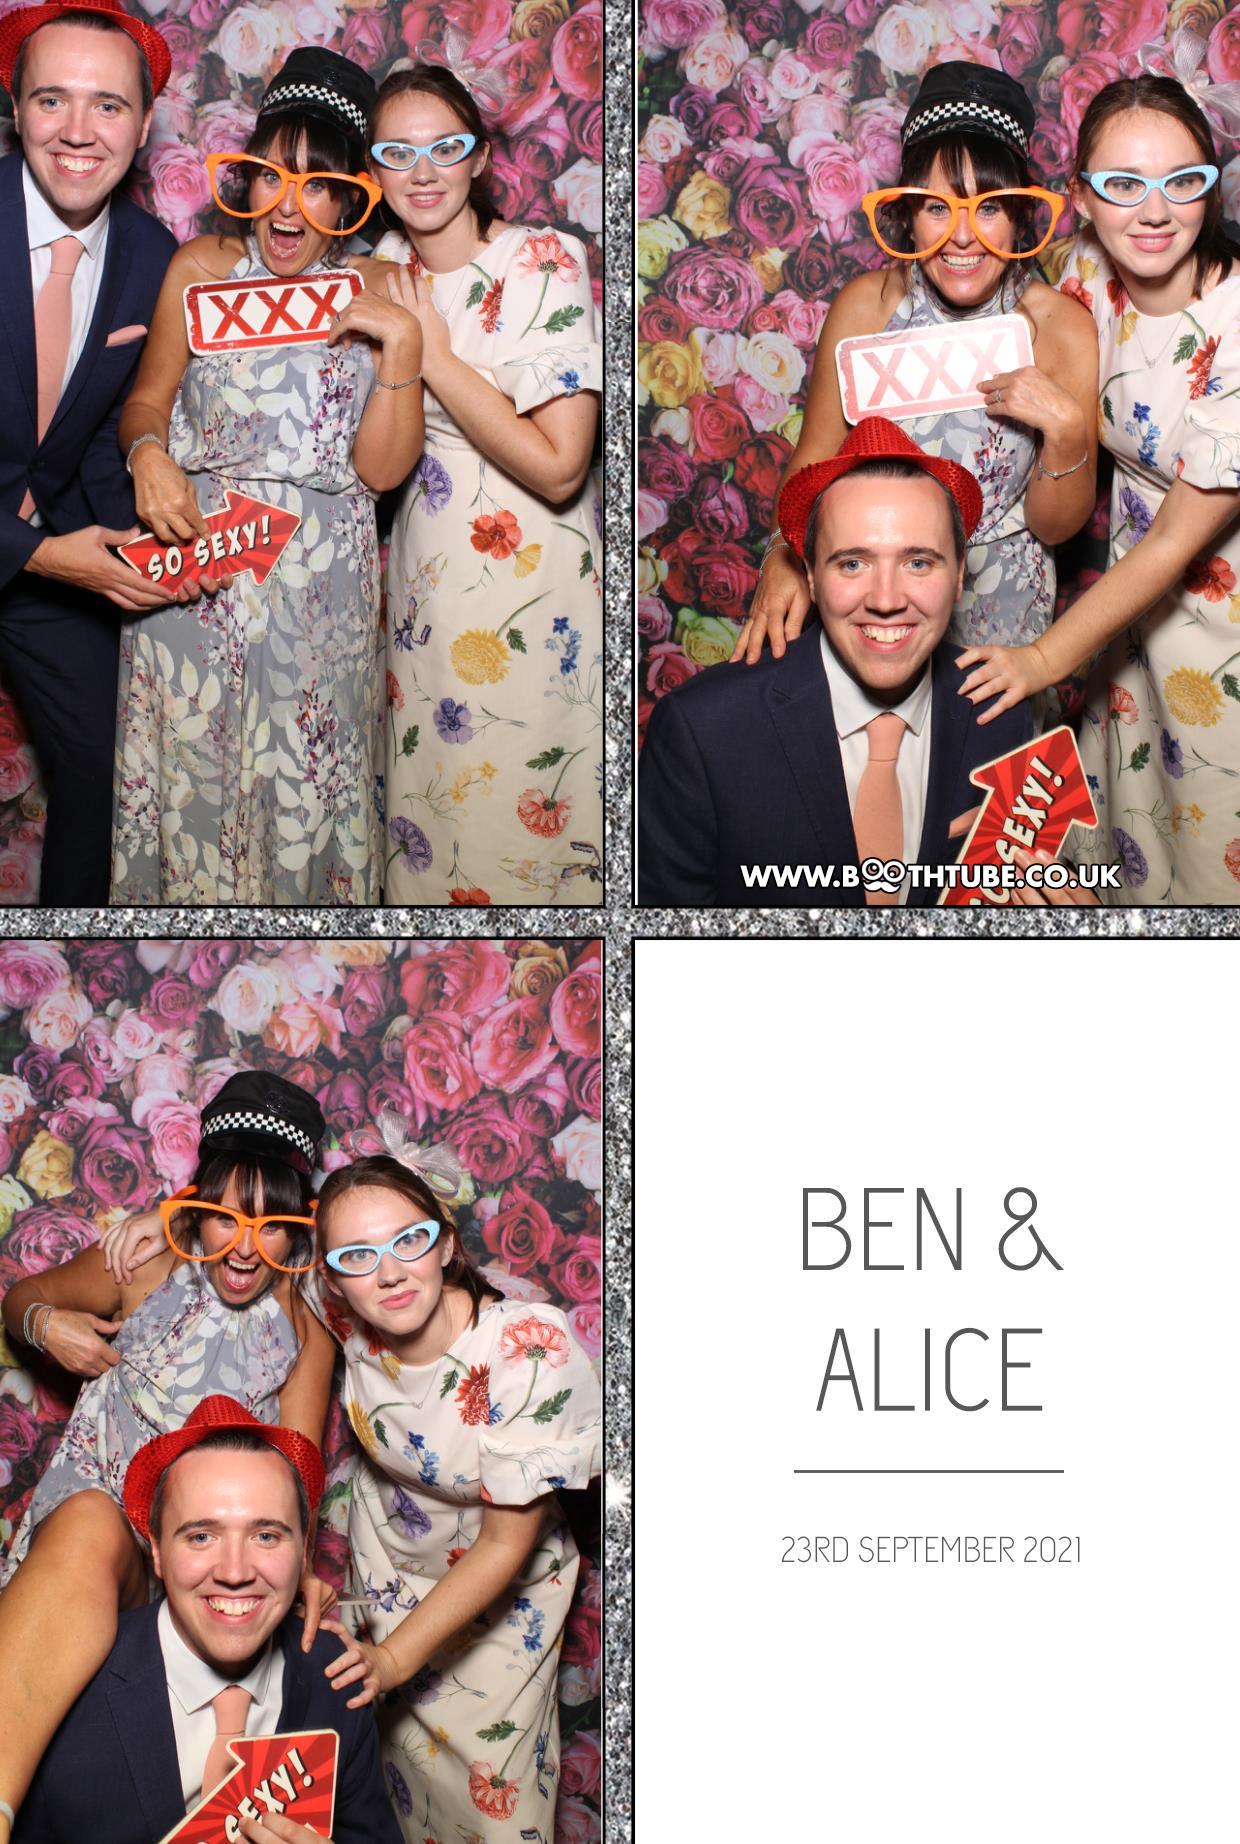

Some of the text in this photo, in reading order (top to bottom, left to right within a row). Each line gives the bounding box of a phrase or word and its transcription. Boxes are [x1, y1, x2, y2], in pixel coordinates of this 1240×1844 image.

[208, 283, 342, 339] XXX
[861, 333, 1007, 407] XXX
[148, 514, 271, 581] SO SEXY!
[994, 755, 1065, 864] SEXY!
